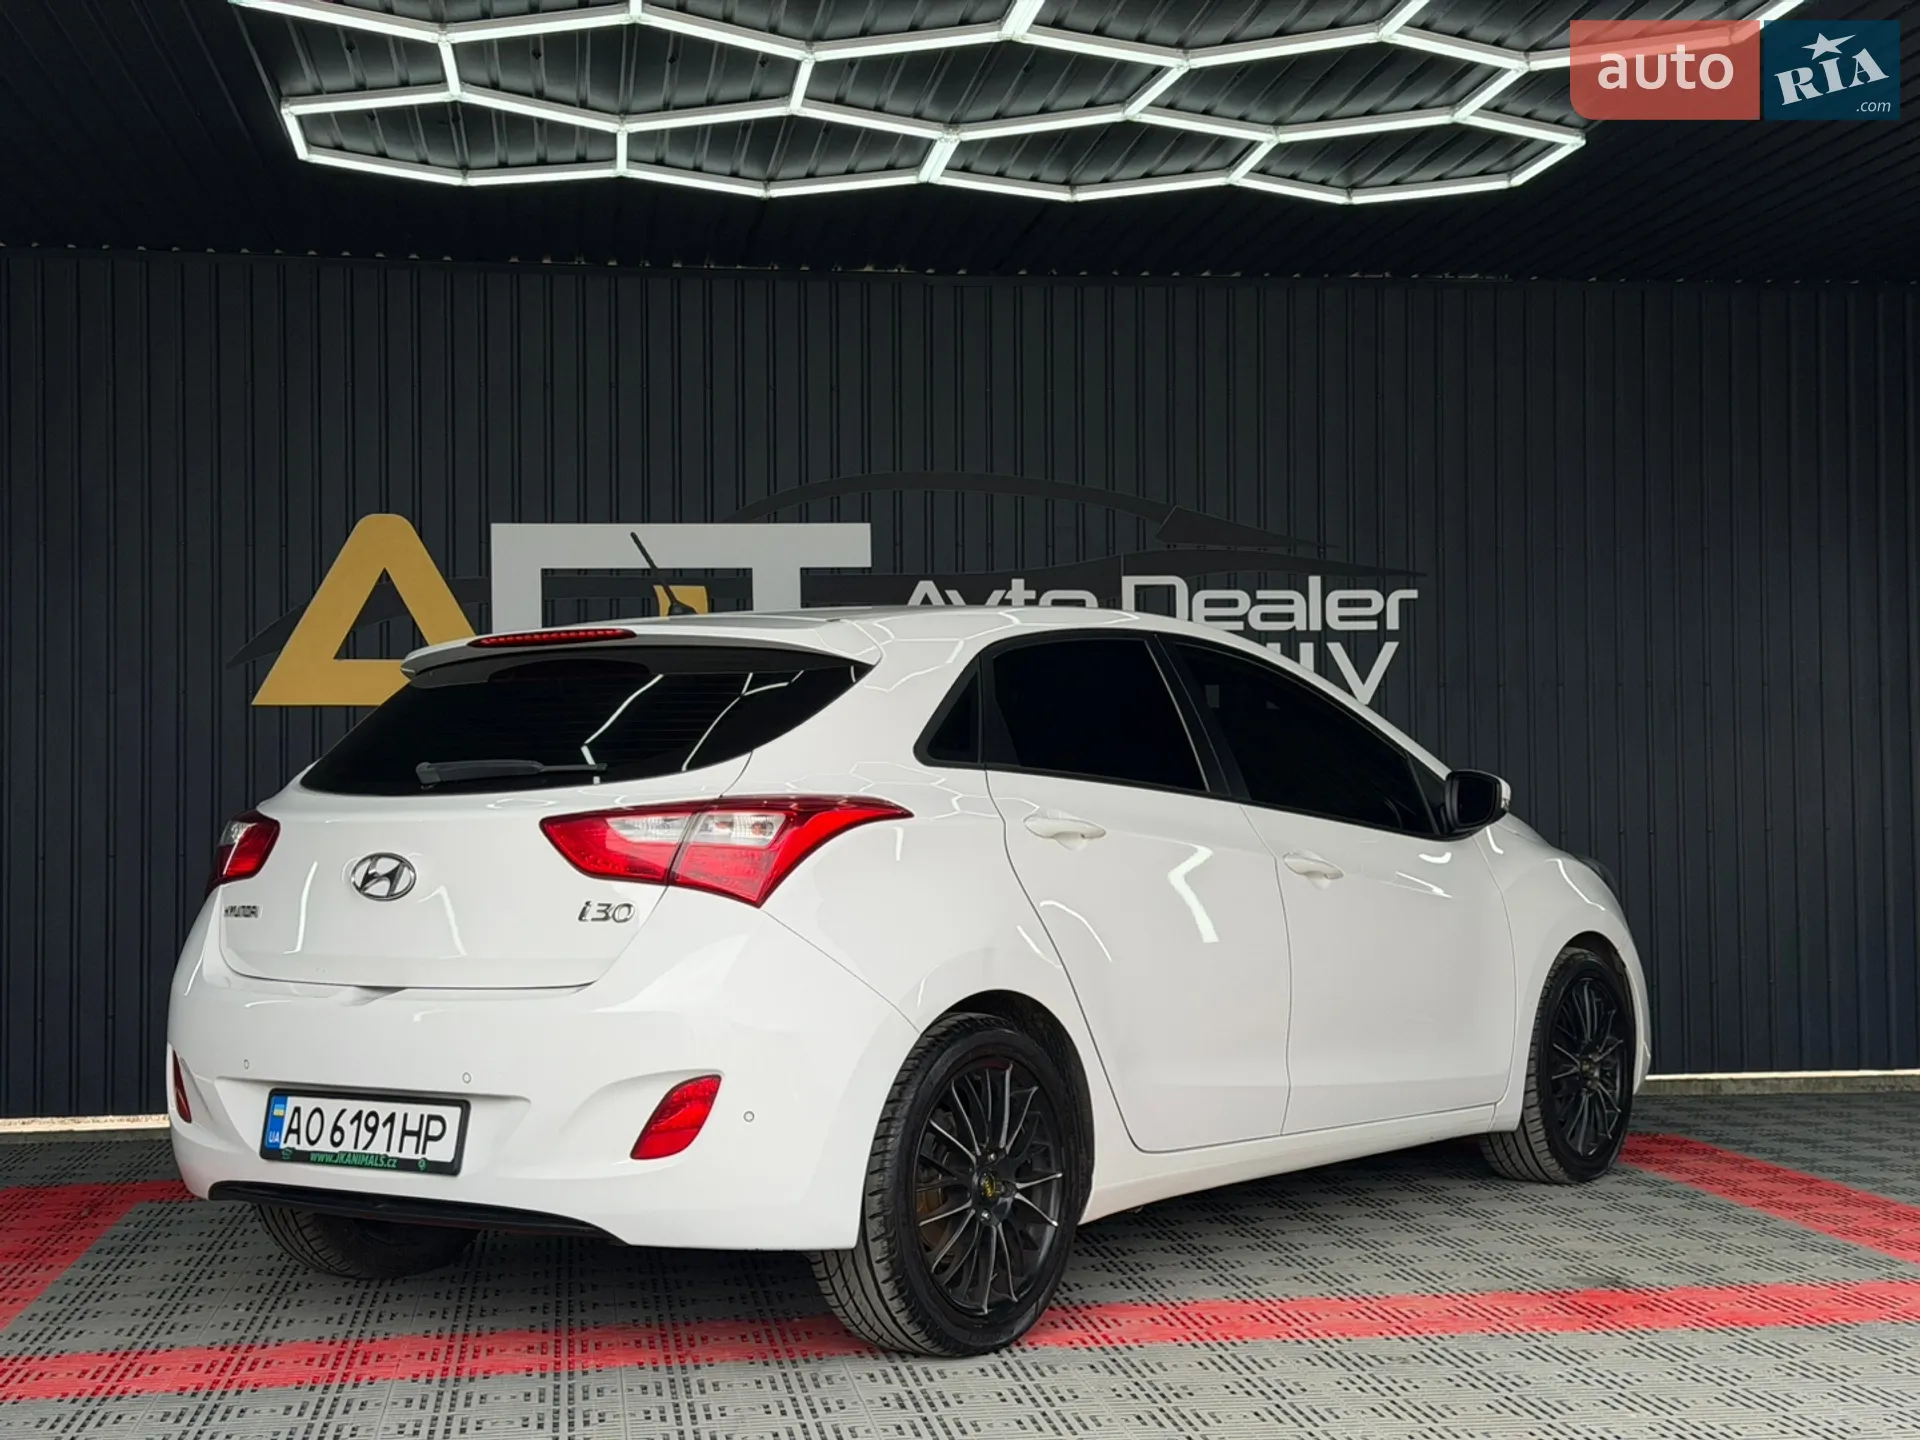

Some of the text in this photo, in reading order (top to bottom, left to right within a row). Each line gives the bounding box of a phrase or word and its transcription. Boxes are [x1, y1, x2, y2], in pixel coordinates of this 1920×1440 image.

[1121, 575, 1418, 631] Dealer
[578, 901, 636, 923] i30
[268, 1131, 280, 1143] UA
